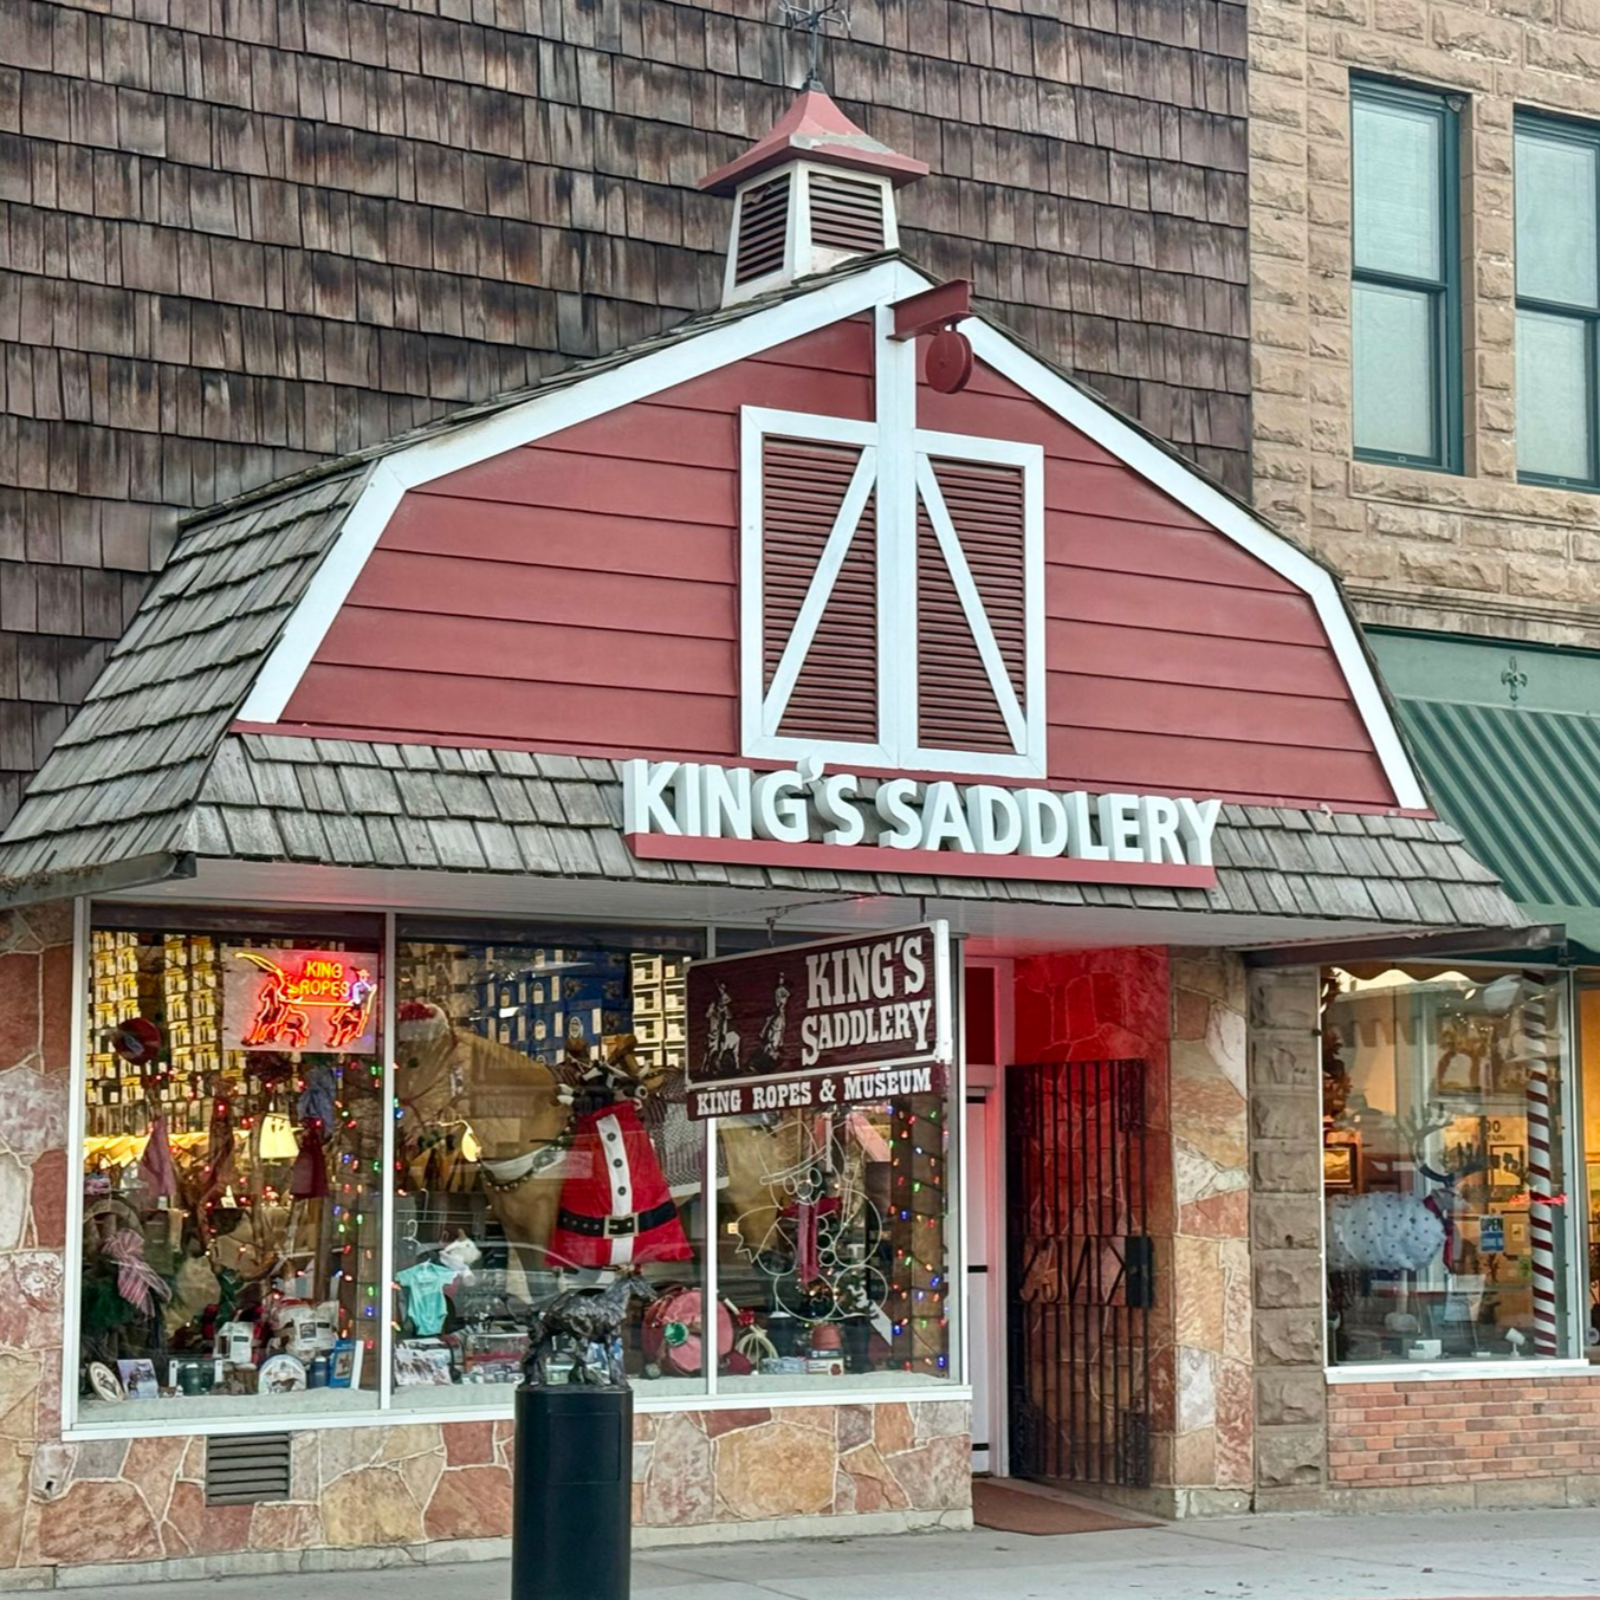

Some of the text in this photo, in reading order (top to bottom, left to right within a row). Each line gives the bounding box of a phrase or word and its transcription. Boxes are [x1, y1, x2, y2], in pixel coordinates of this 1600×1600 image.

[623, 756, 1222, 866] KING'S SADDLERY
[299, 978, 350, 997] ROPES
[306, 960, 343, 978] KING
[805, 935, 926, 1010] KING'S
[801, 999, 932, 1066] SADDLERY
[696, 1067, 932, 1116] KING ROPES & MUSEUM
